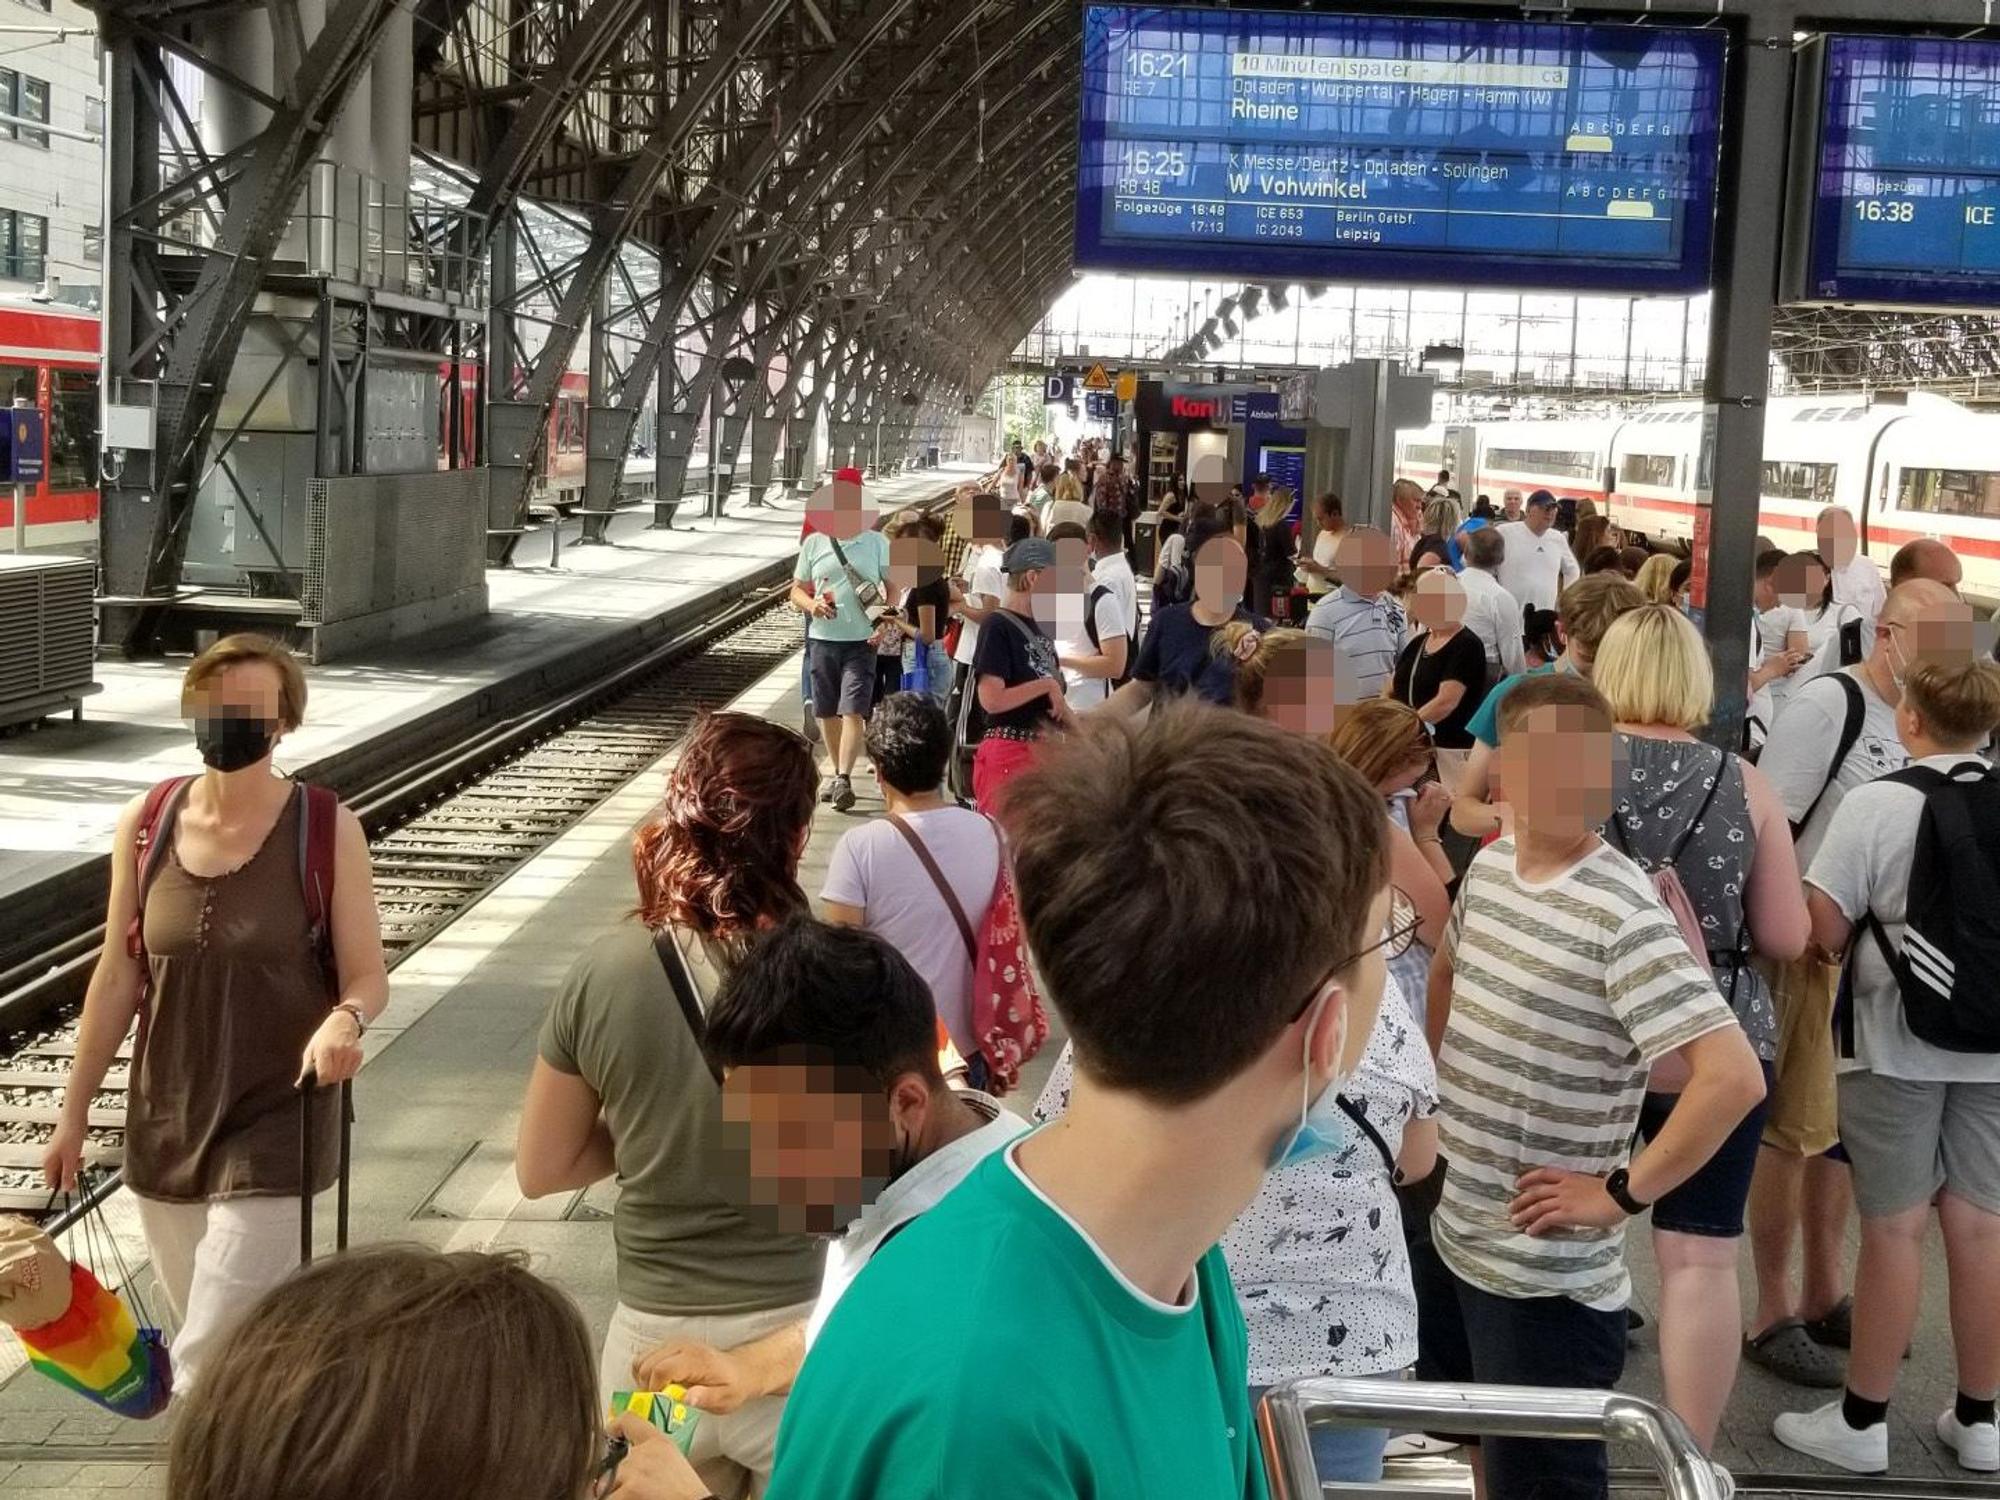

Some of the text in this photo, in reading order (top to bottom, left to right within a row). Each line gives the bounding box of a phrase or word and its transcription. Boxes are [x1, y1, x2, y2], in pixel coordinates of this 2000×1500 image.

[1127, 52, 1188, 78] 16:21
[1241, 55, 1260, 71] 10
[1265, 56, 1341, 75] Minuten
[1124, 80, 1156, 96] RE 7
[1233, 77, 1296, 96] Opladen
[1312, 81, 1393, 101] Wuppertal
[1411, 85, 1459, 104] Hagen
[1475, 87, 1520, 105] Hamm
[1524, 90, 1552, 105] (W)
[1232, 97, 1298, 120] Rheine
[1571, 122, 1580, 133] A
[1123, 151, 1184, 176] 16:25
[1229, 153, 1239, 169] K
[1244, 154, 1349, 173] Messe/Deutz
[1365, 159, 1427, 178] Opladen
[1443, 162, 1509, 183] Solingen
[1119, 179, 1161, 195] RB 48
[1229, 174, 1368, 199] W Vohwinkel
[1566, 185, 1576, 196] A
[1612, 187, 1621, 198] D
[1627, 187, 1635, 198] E
[1256, 206, 1277, 219] ICE
[1337, 210, 1375, 223] Berlin
[1855, 200, 1996, 225] 16:38 ICE
[1336, 228, 1382, 243] Leipzig
[40, 367, 48, 392] 2
[1047, 376, 1064, 399] D
